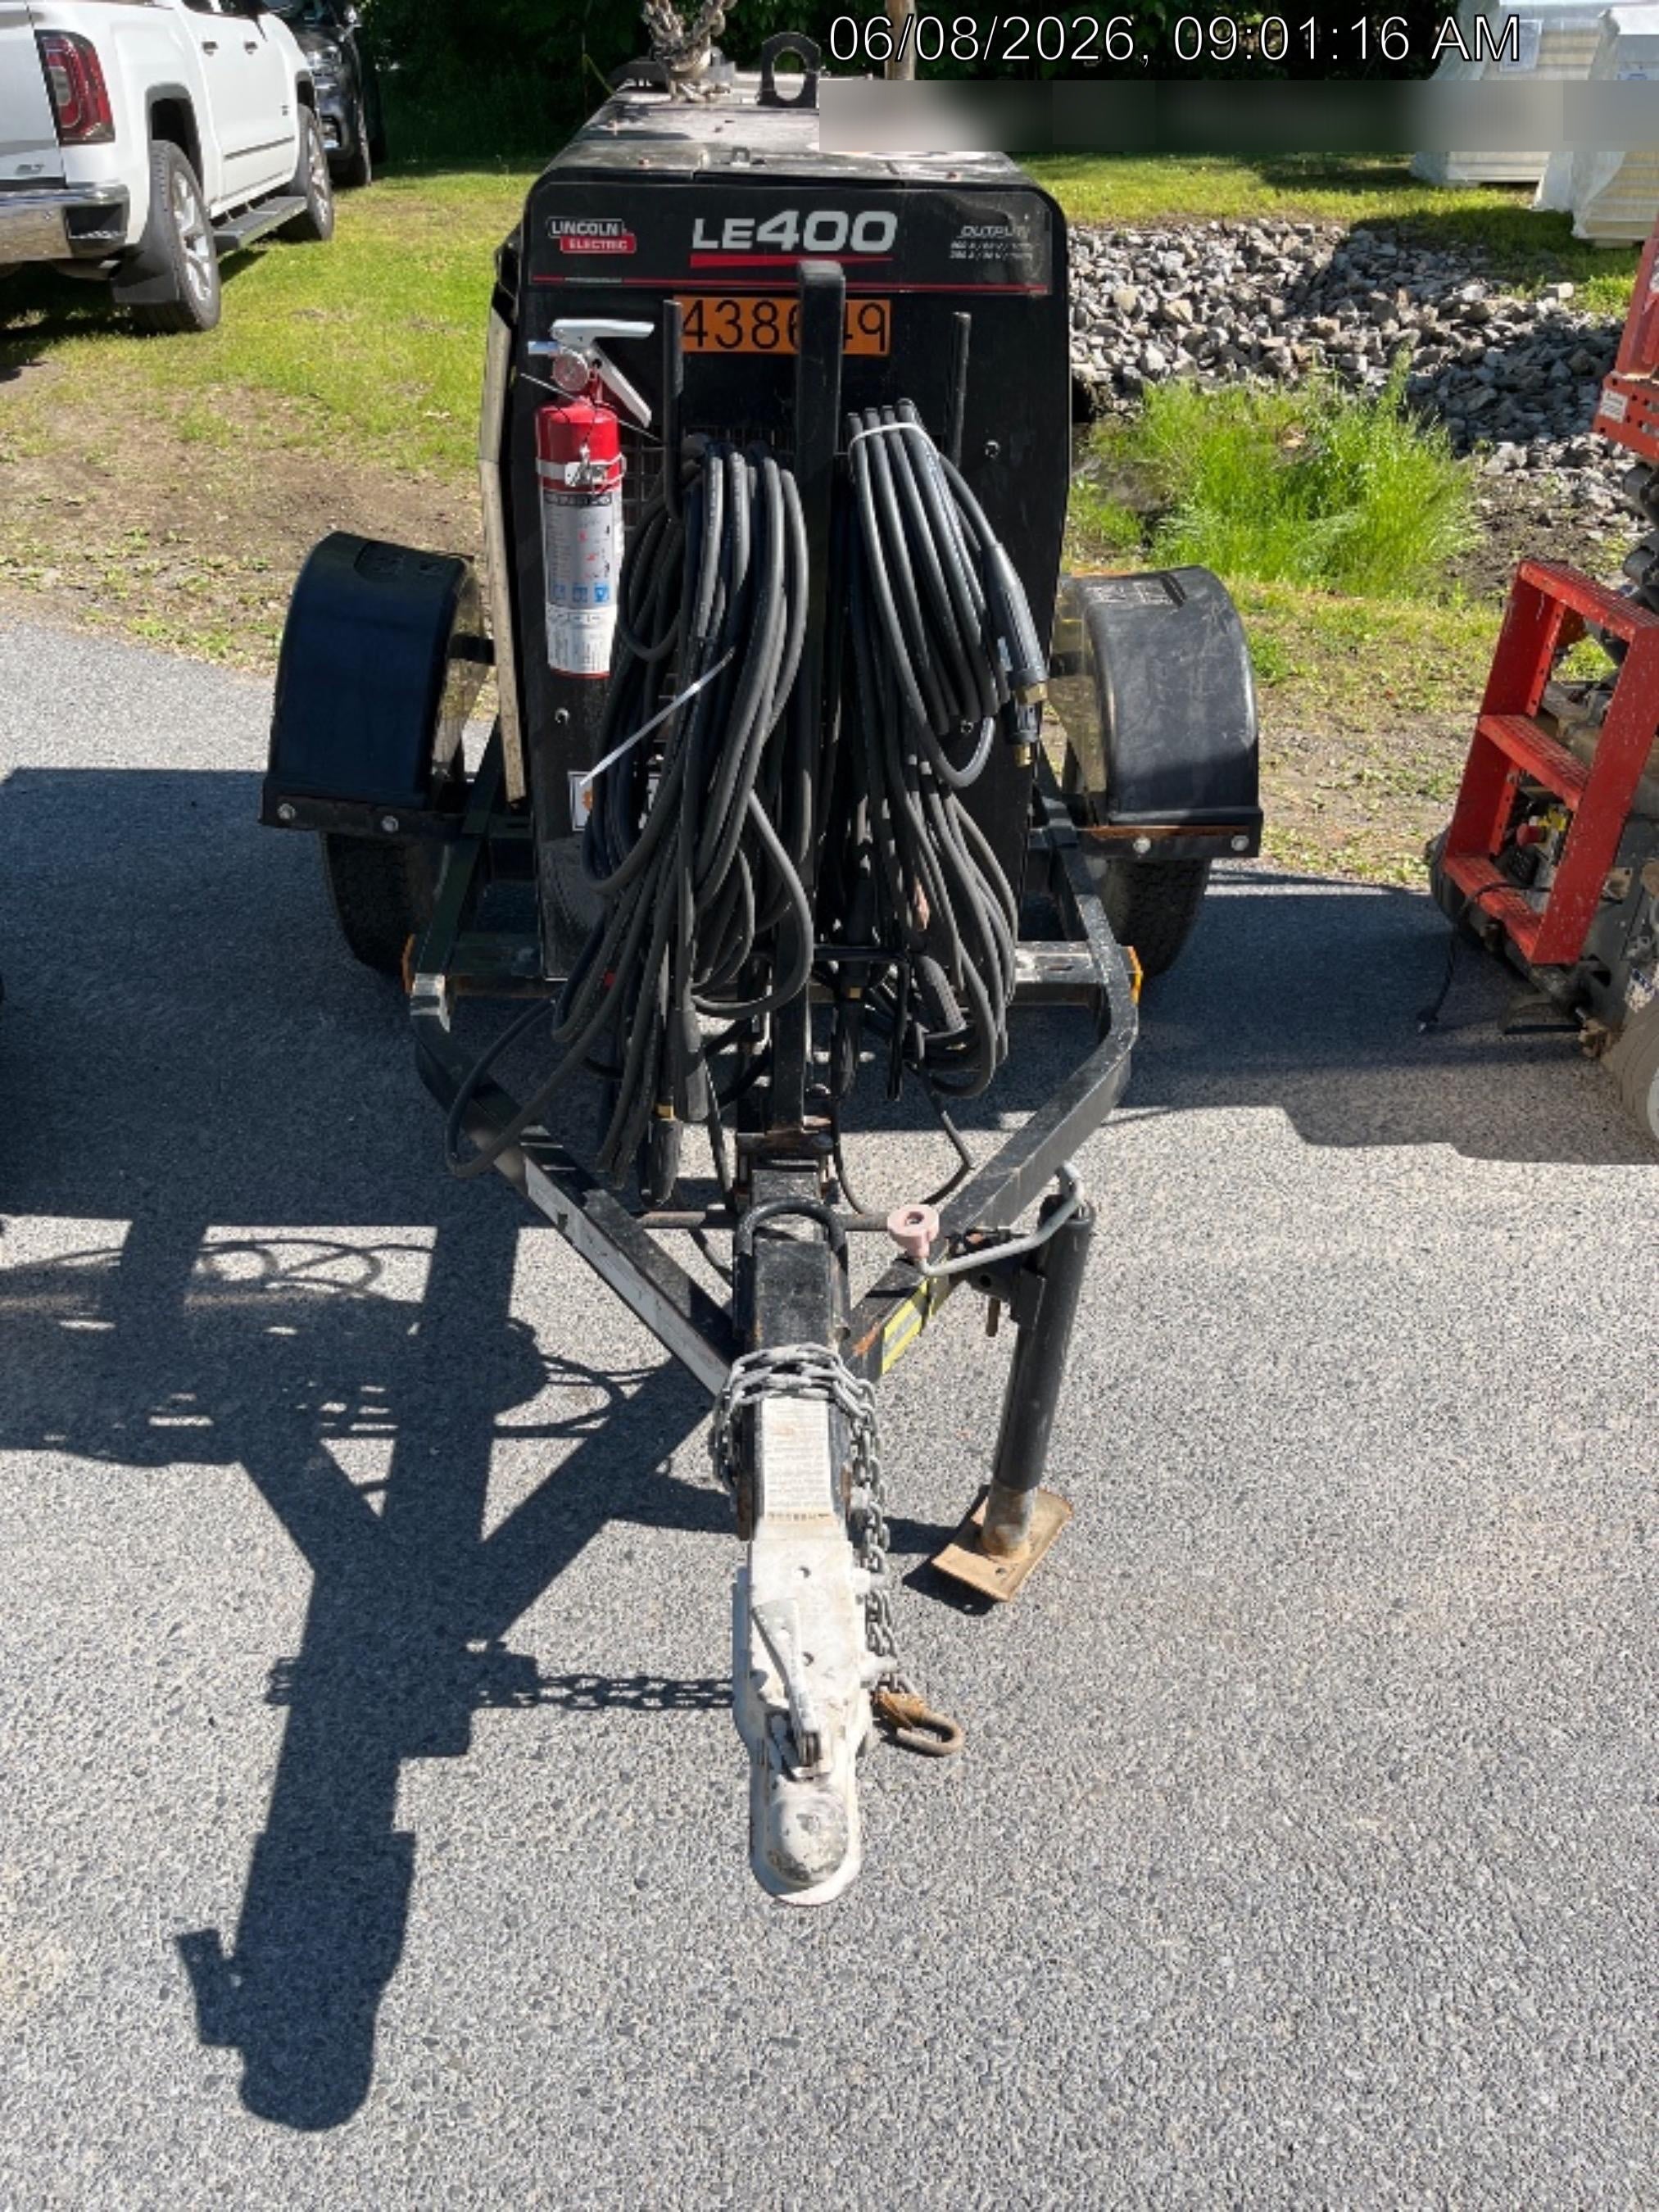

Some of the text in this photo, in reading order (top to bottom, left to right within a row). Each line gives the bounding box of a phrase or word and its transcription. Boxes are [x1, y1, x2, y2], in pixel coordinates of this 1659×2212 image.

[551, 220, 618, 236] LINCOLN
[691, 210, 899, 252] LE400
[569, 238, 628, 250] ELECTRIC
